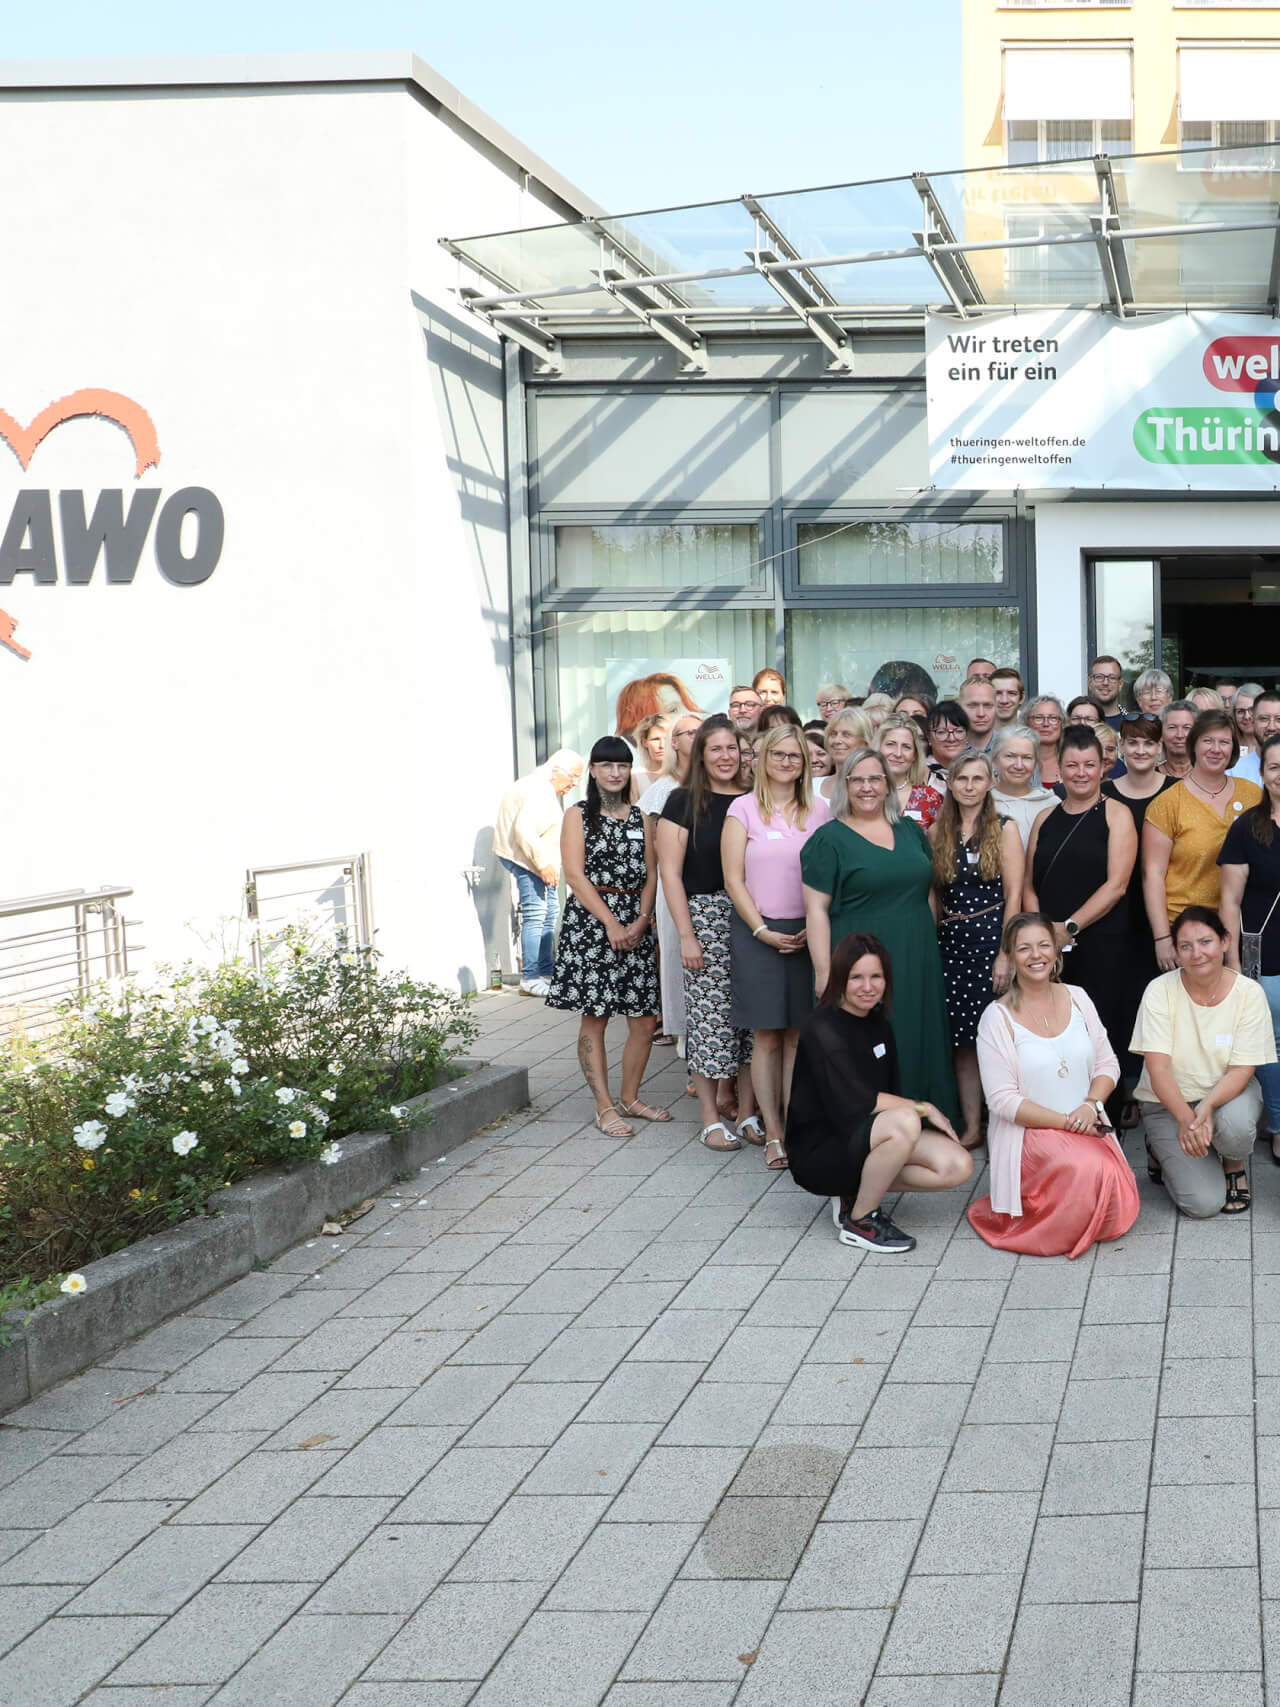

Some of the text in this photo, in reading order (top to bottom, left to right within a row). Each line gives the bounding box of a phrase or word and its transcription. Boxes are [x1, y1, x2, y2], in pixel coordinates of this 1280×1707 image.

[948, 335, 1059, 353] Wir treten
[948, 361, 1057, 381] ein für ein
[950, 437, 1086, 449] thueringen-weltoffen.de
[951, 454, 1072, 466] #thueringenweltoffen
[0, 486, 225, 587] AWO
